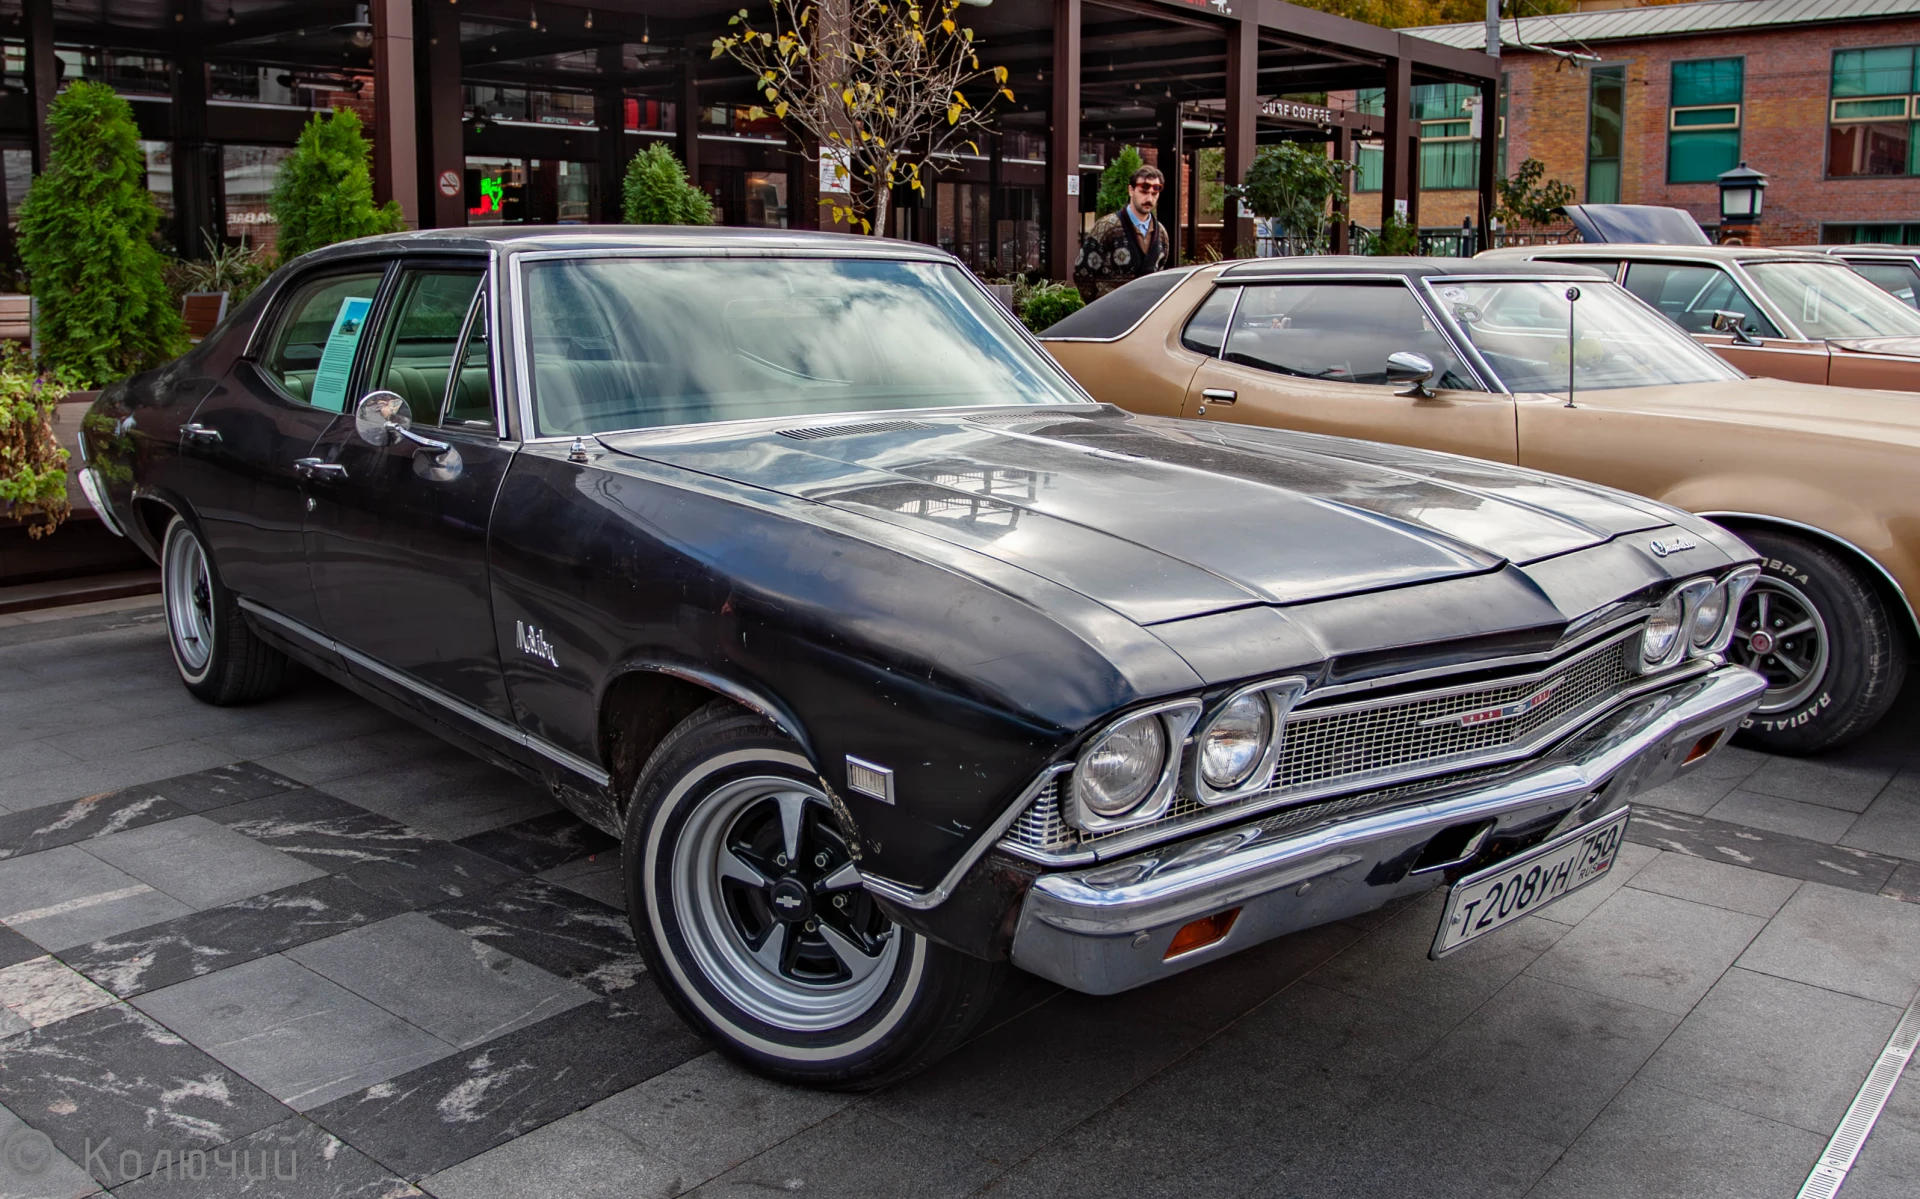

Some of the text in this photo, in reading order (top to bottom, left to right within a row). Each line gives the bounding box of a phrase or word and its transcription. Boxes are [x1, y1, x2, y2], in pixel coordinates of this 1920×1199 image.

[1262, 102, 1331, 122] SURF COFFEE
[516, 620, 559, 668] Malibu
[1761, 691, 1832, 732] RADIAL
[1577, 824, 1619, 871] 750
[1578, 864, 1598, 882] RUS
